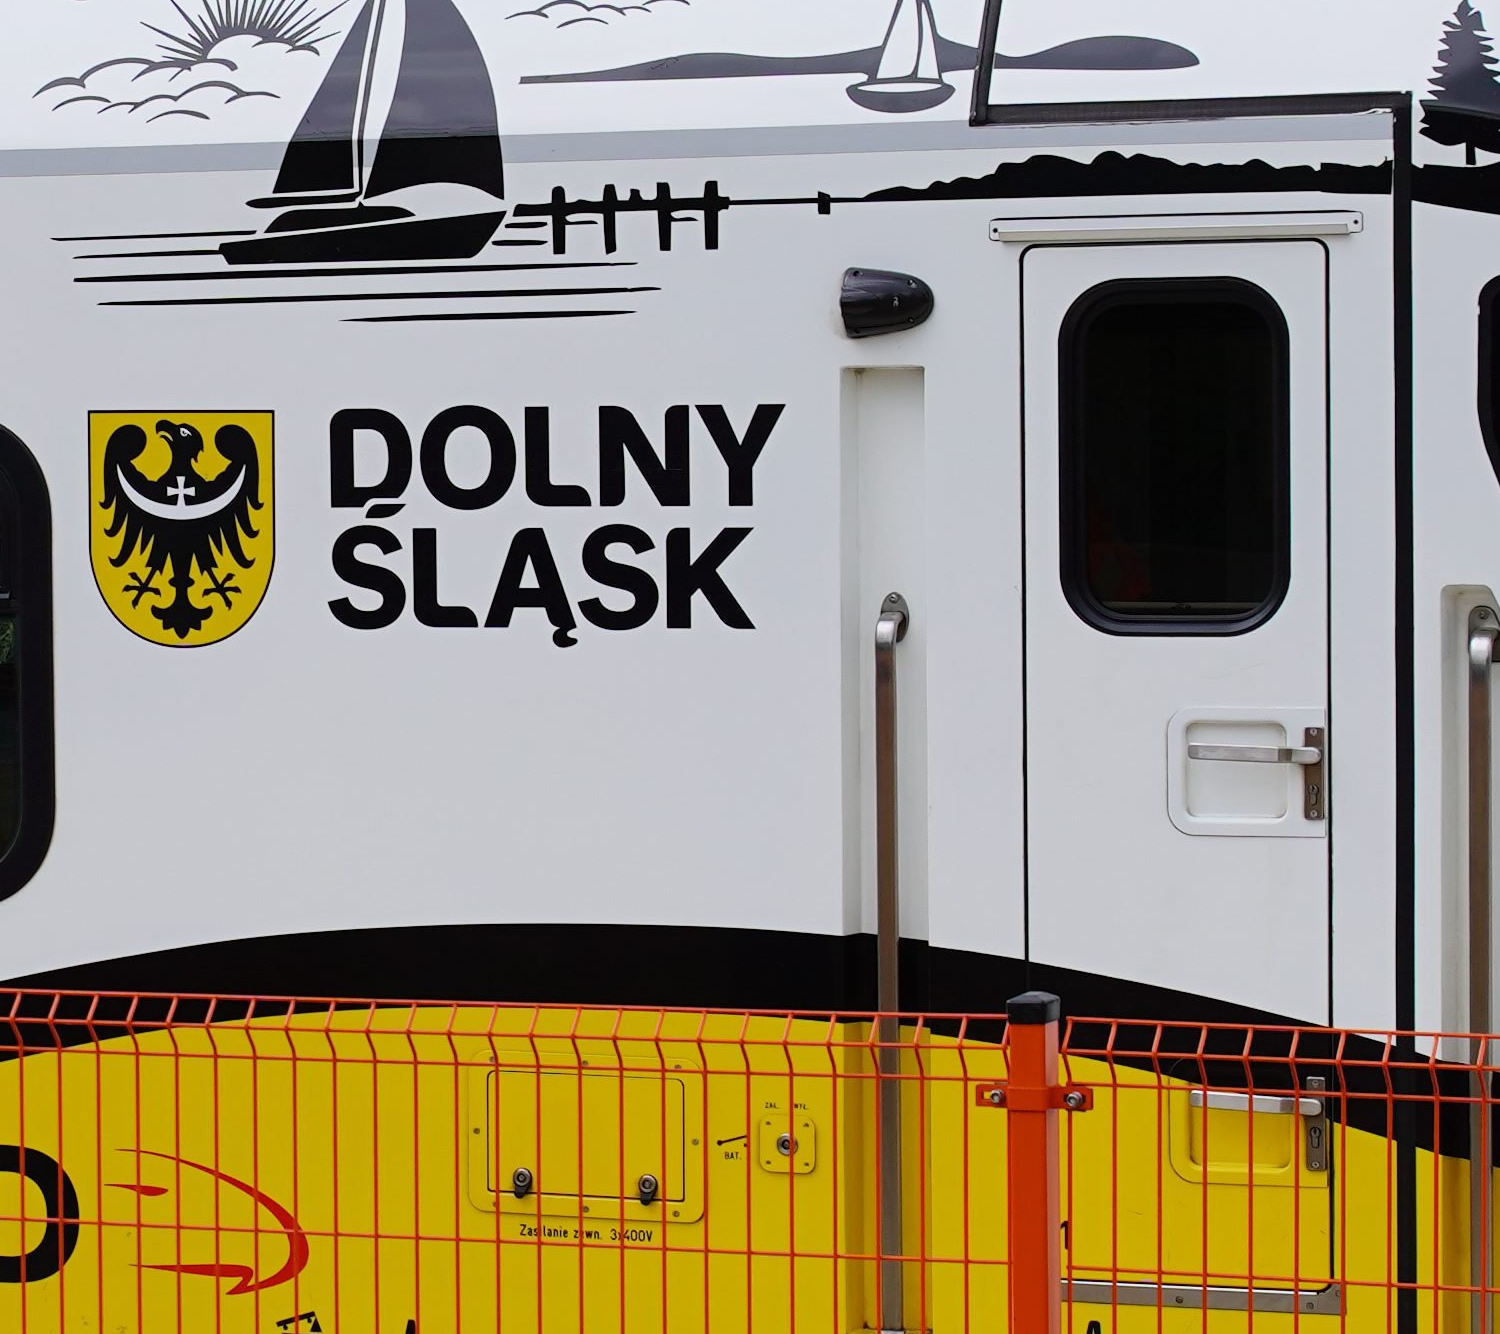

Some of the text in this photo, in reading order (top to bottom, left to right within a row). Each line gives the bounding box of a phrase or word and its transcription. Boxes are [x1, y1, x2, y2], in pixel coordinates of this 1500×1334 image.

[328, 403, 787, 511] DOLNY
[327, 503, 757, 648] ŚLĄSK
[519, 1223, 569, 1238] Zaslanie
